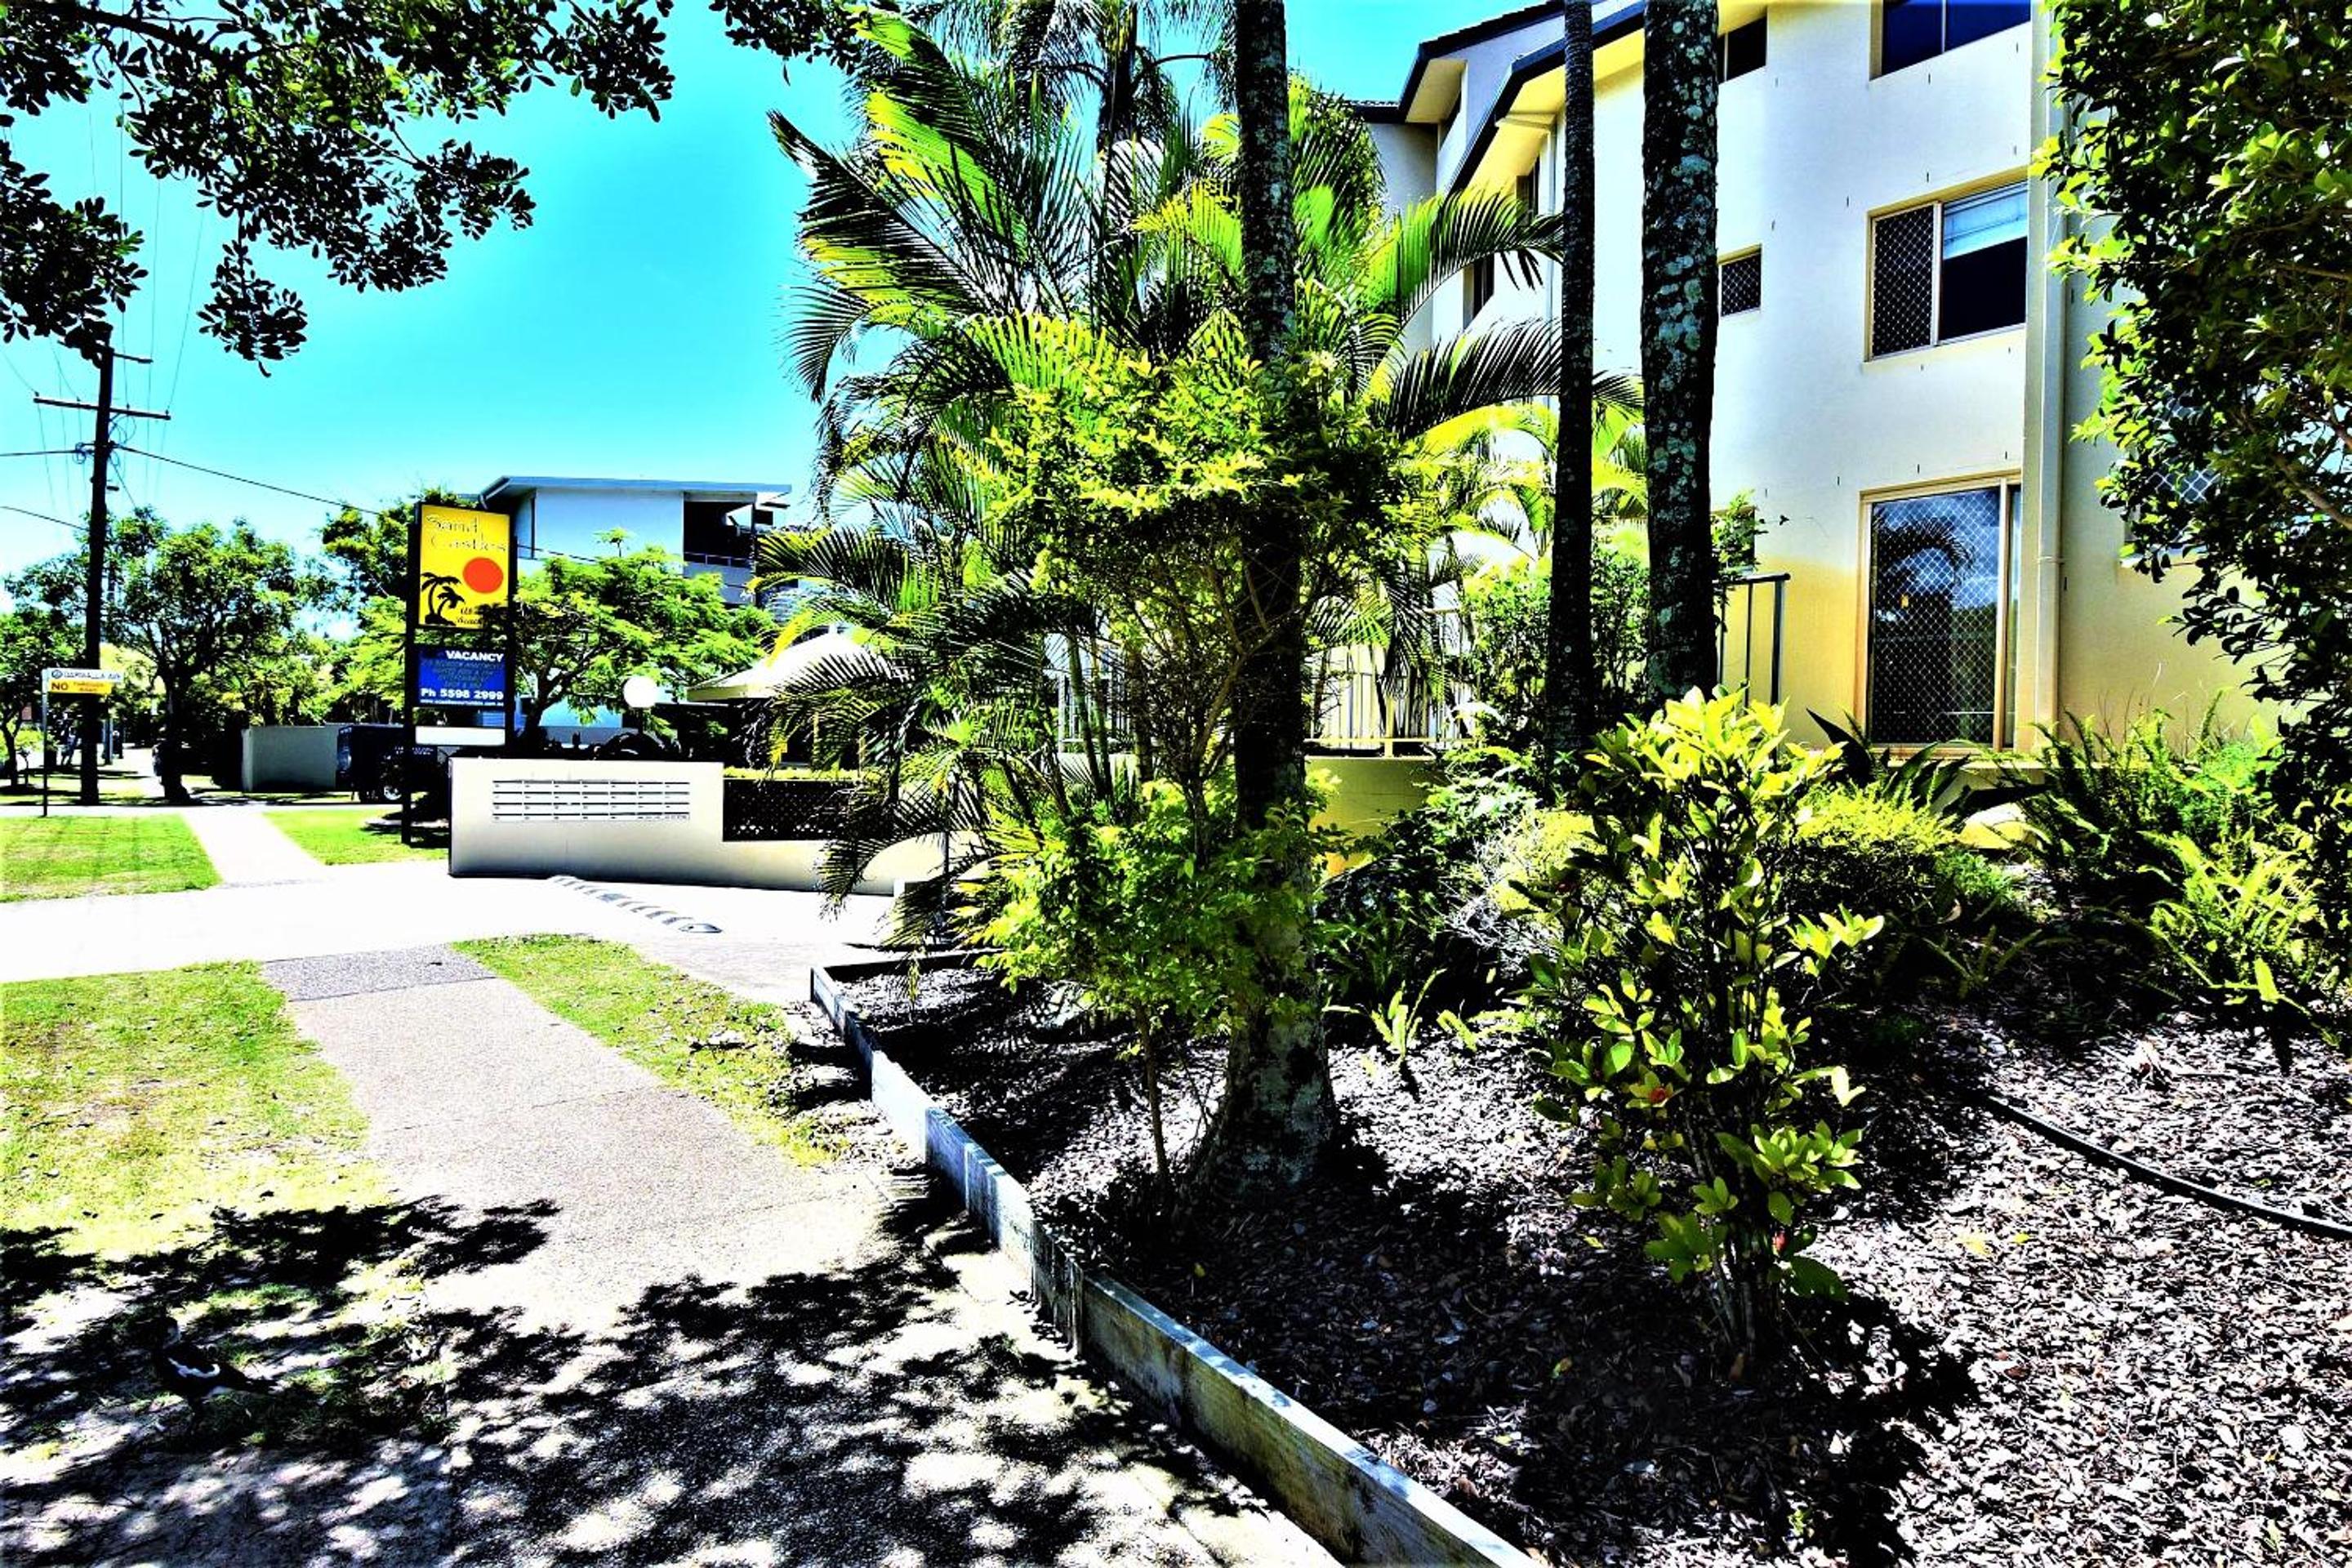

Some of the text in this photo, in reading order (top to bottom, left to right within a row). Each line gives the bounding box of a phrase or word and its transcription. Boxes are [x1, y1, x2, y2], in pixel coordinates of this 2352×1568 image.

[445, 650, 504, 662] VACANCY
[51, 683, 69, 691] NO
[421, 688, 436, 697] Ph
[440, 688, 470, 698] 5598
